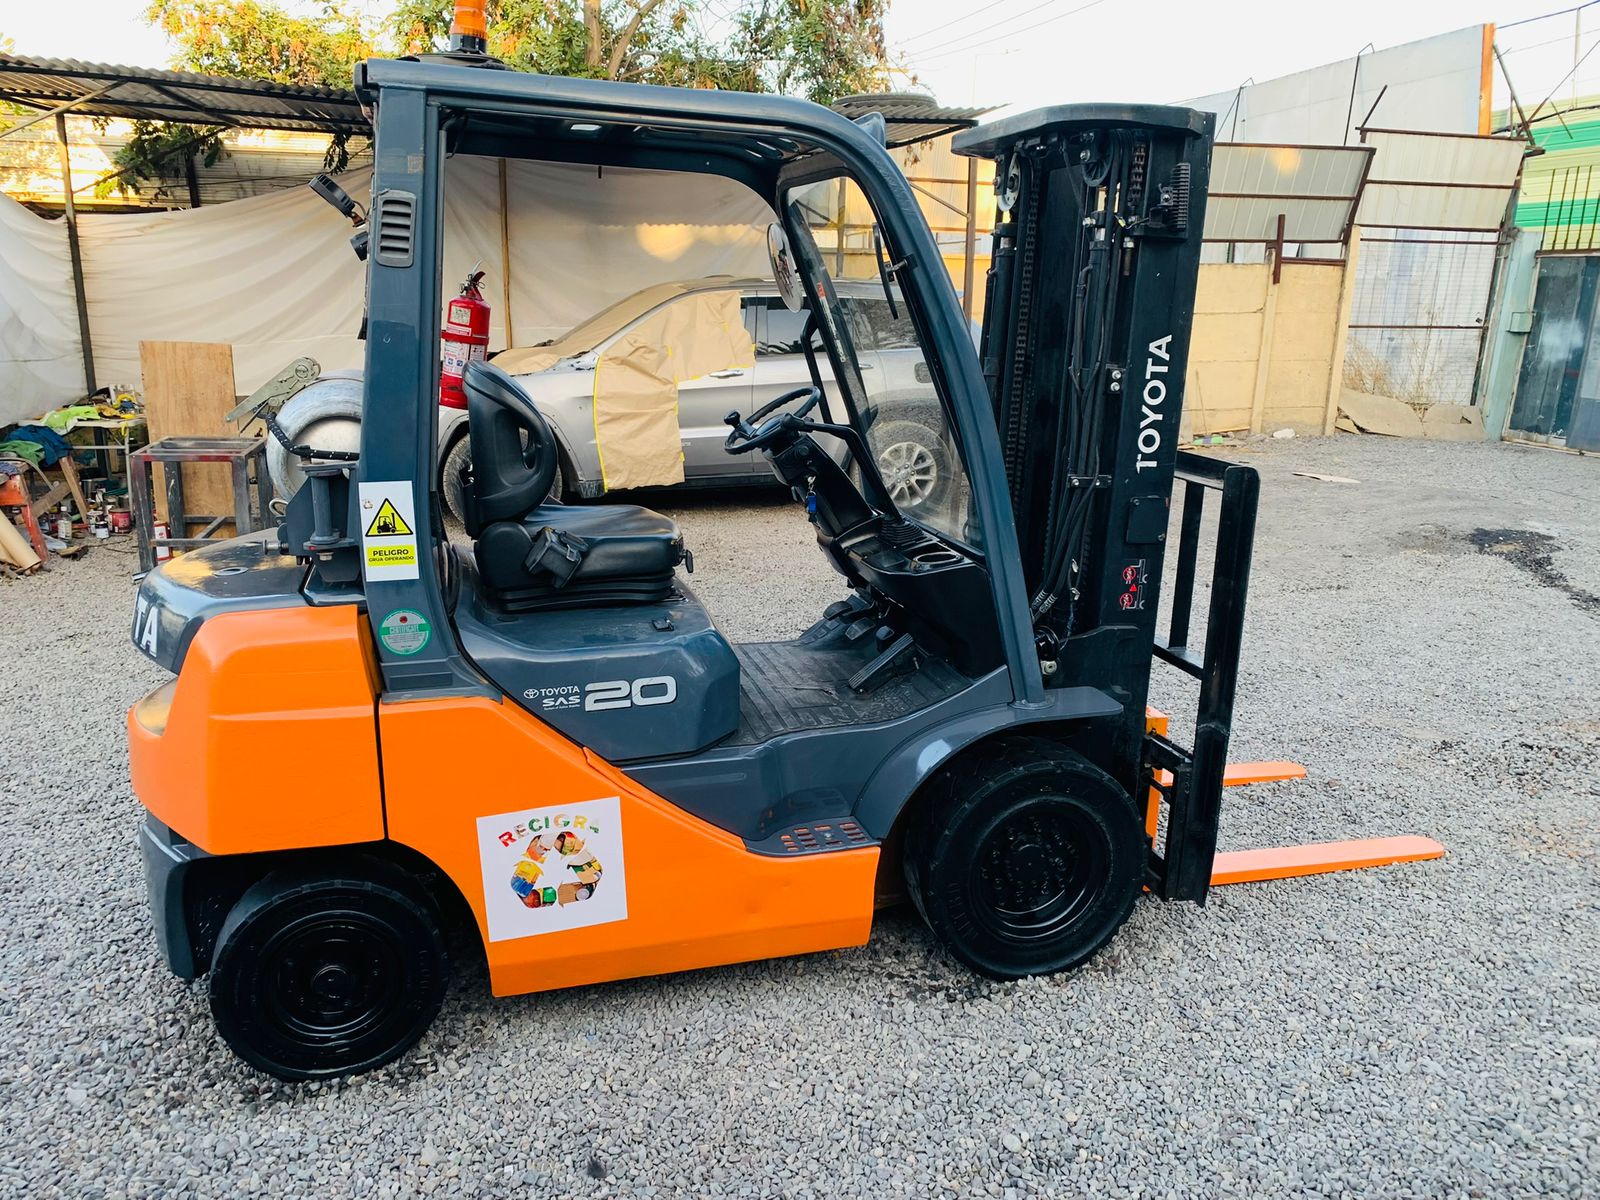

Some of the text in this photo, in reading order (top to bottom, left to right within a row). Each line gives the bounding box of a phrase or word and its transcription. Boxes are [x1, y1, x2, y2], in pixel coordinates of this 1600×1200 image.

[1136, 334, 1172, 474] TOYOTA
[373, 549, 409, 557] PELIGRO
[540, 686, 580, 696] TOYOTA
[585, 675, 677, 712] 20
[542, 695, 581, 707] SAS
